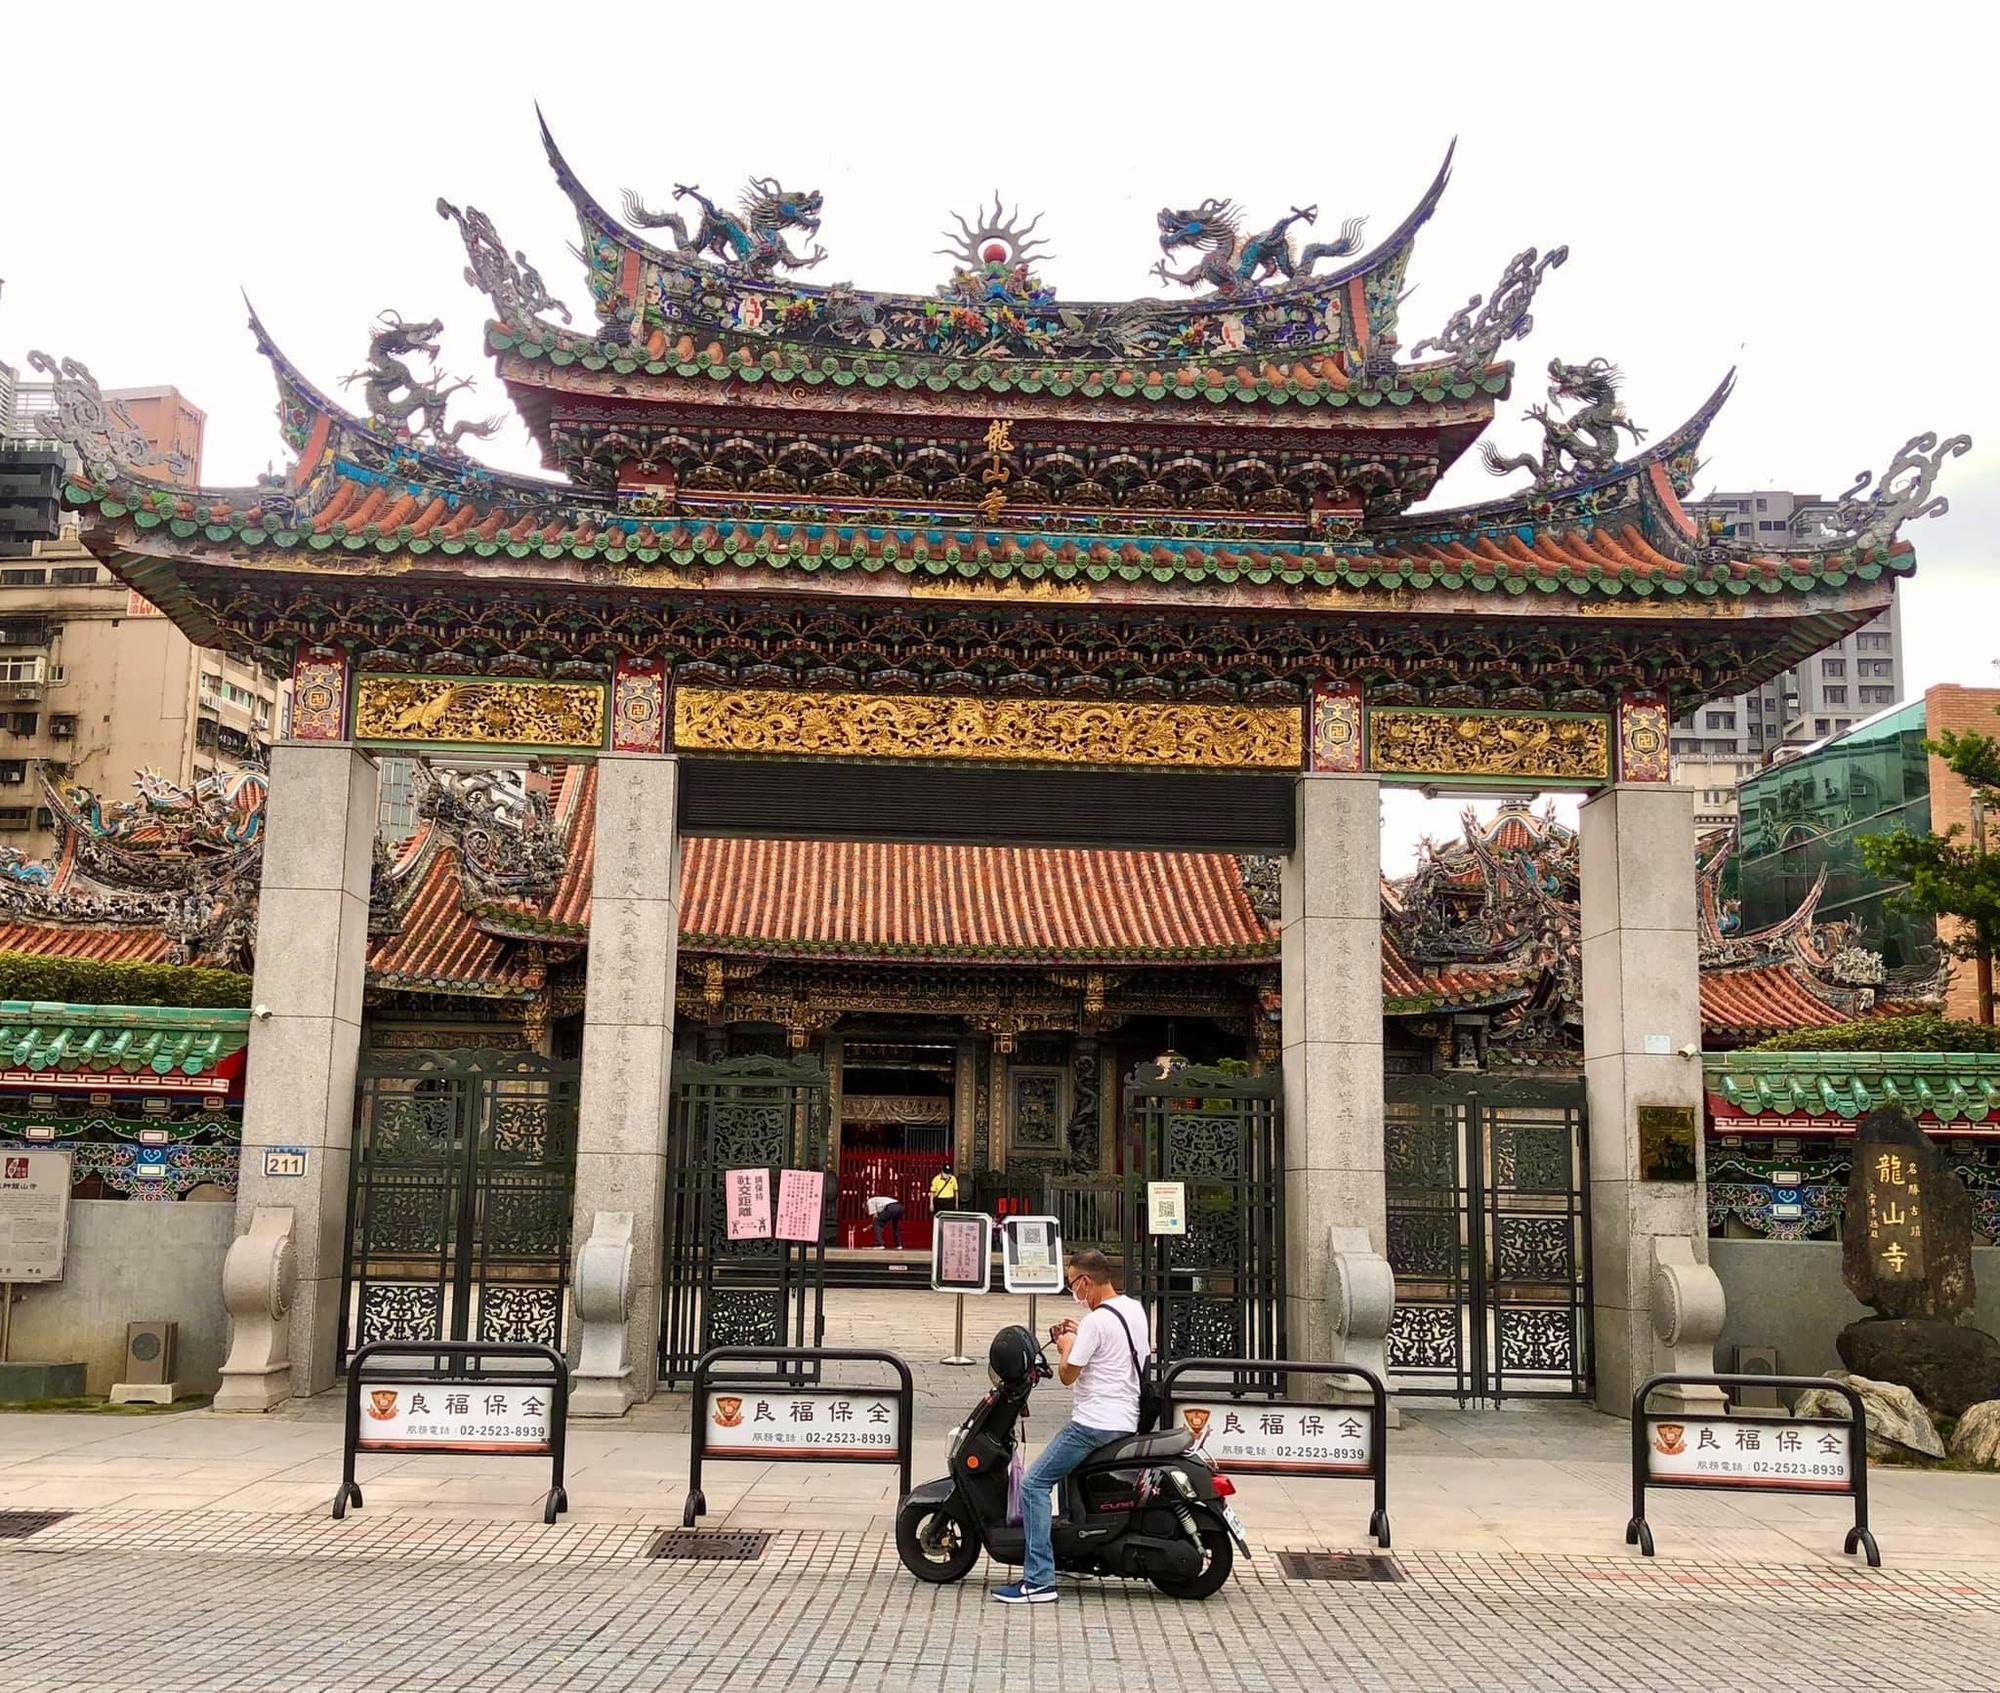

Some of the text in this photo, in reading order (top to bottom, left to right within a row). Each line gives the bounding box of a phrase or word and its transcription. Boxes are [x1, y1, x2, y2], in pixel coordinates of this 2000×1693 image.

[978, 420, 1014, 523] 龍山寺
[269, 1158, 299, 1173] 211
[737, 1174, 752, 1217] 社交距離
[1875, 1153, 1908, 1273] 龍山寺
[408, 1392, 546, 1417] 良福保全
[753, 1400, 891, 1423] 良福保全
[1222, 1411, 1364, 1438] 良福保全
[1697, 1427, 1843, 1455] 良福保全
